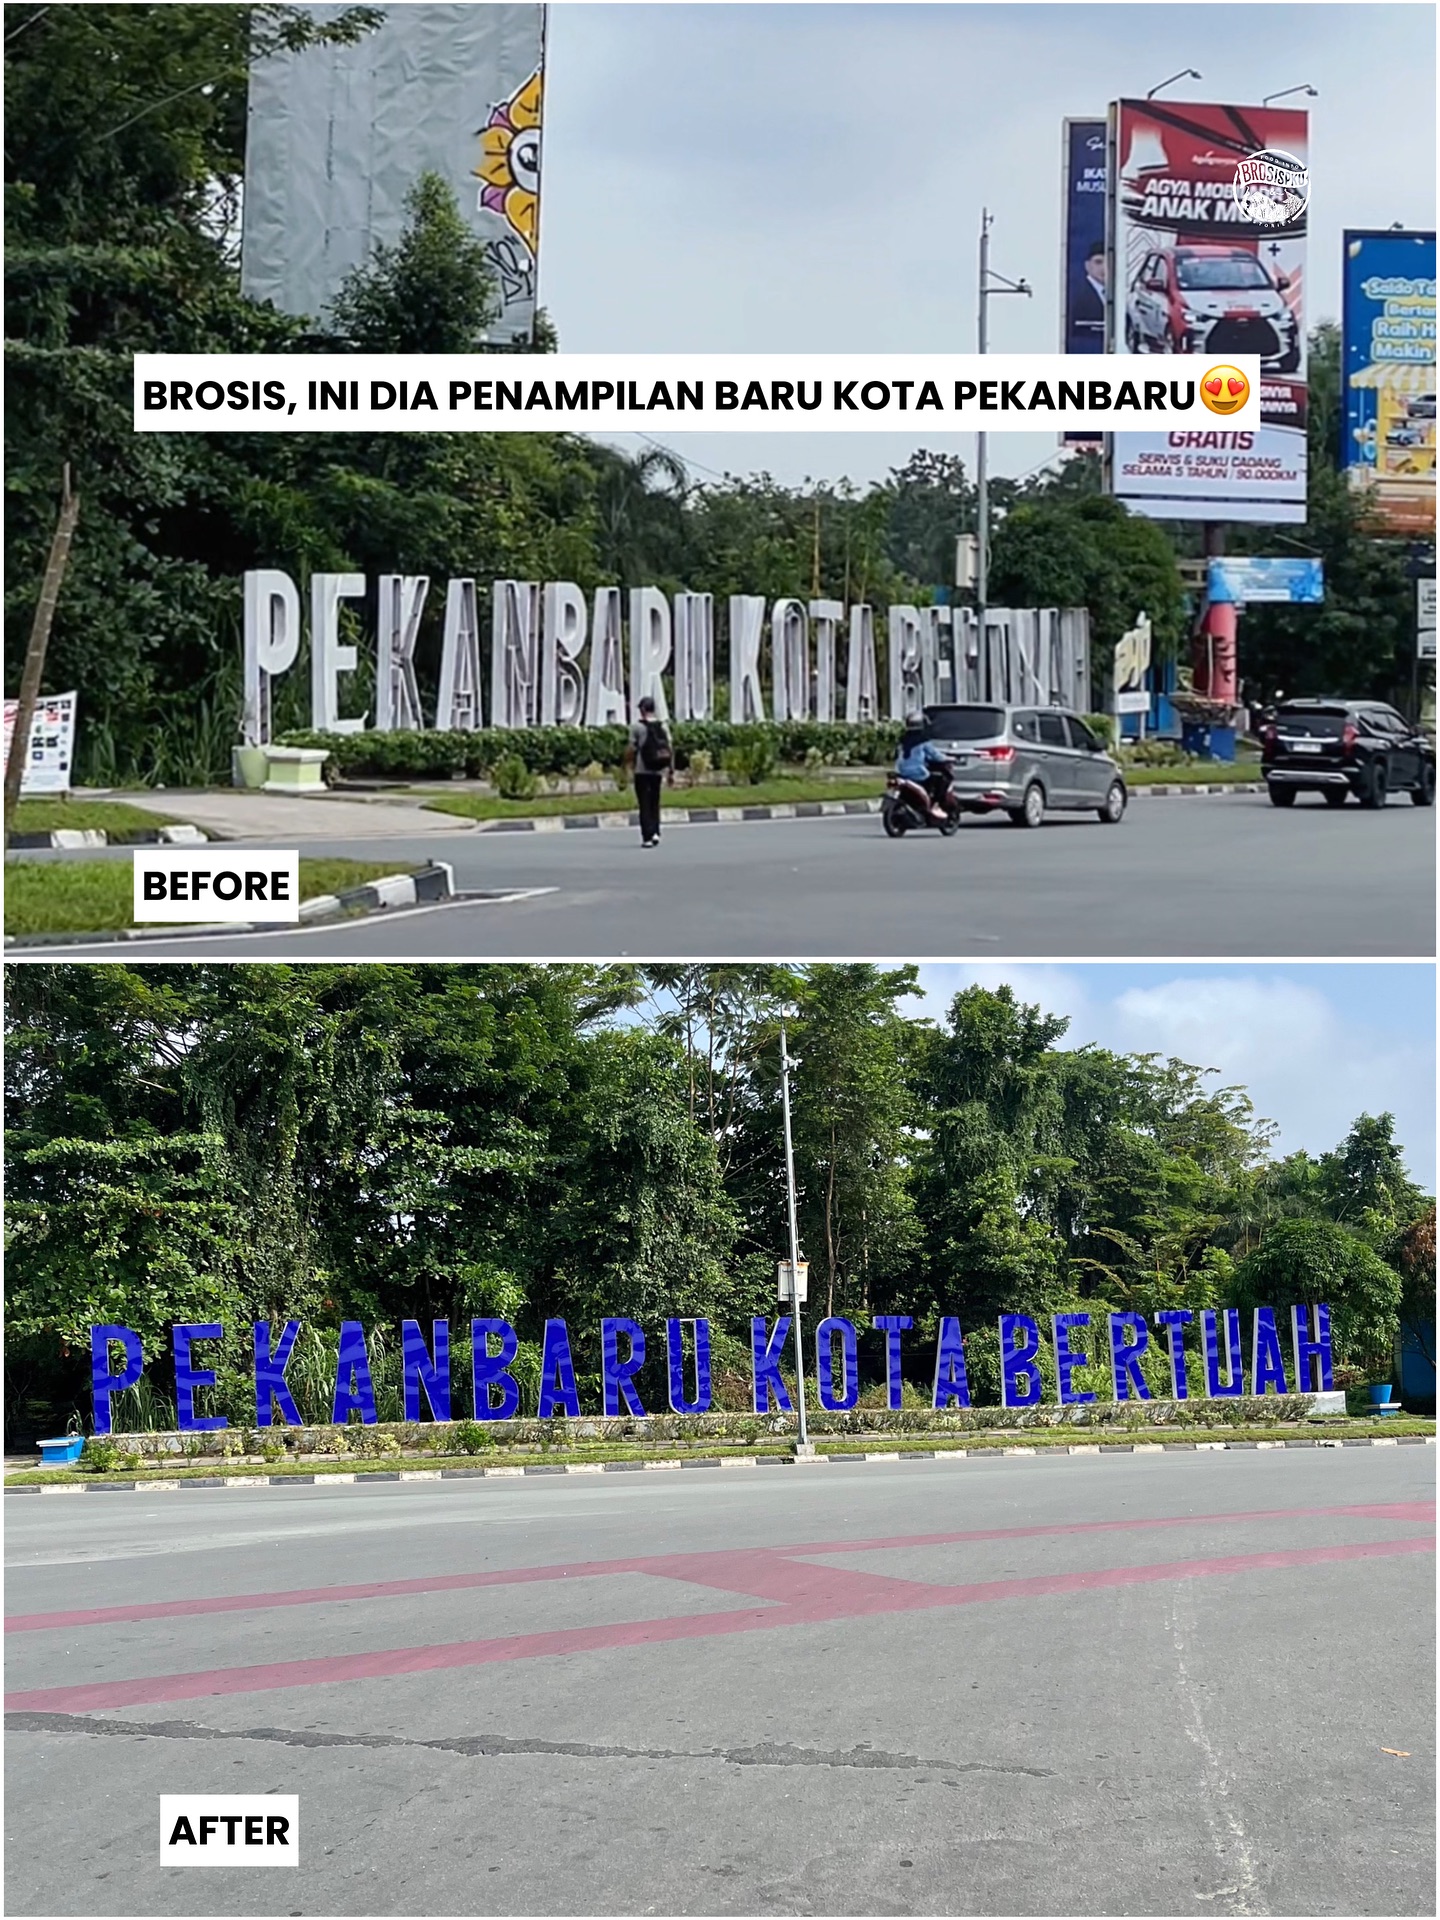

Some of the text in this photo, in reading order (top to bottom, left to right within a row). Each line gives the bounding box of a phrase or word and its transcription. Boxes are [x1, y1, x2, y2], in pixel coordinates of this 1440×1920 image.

[1144, 178, 1191, 197] AGYA
[1140, 197, 1210, 219] ANAK
[1378, 320, 1418, 337] Raih
[1375, 341, 1432, 359] Makin
[1169, 431, 1254, 451] GRATIS
[1138, 452, 1182, 466] SERVIS
[1195, 455, 1230, 468] SUKU
[1231, 456, 1282, 470] CADANG
[1122, 463, 1173, 478] SELAMA
[1187, 466, 1228, 480] TAHUN
[243, 568, 716, 746] PEKANBARU
[729, 594, 879, 724] KOTA
[90, 1304, 1334, 1434] PEKANBARU KOTA BERTUAH
